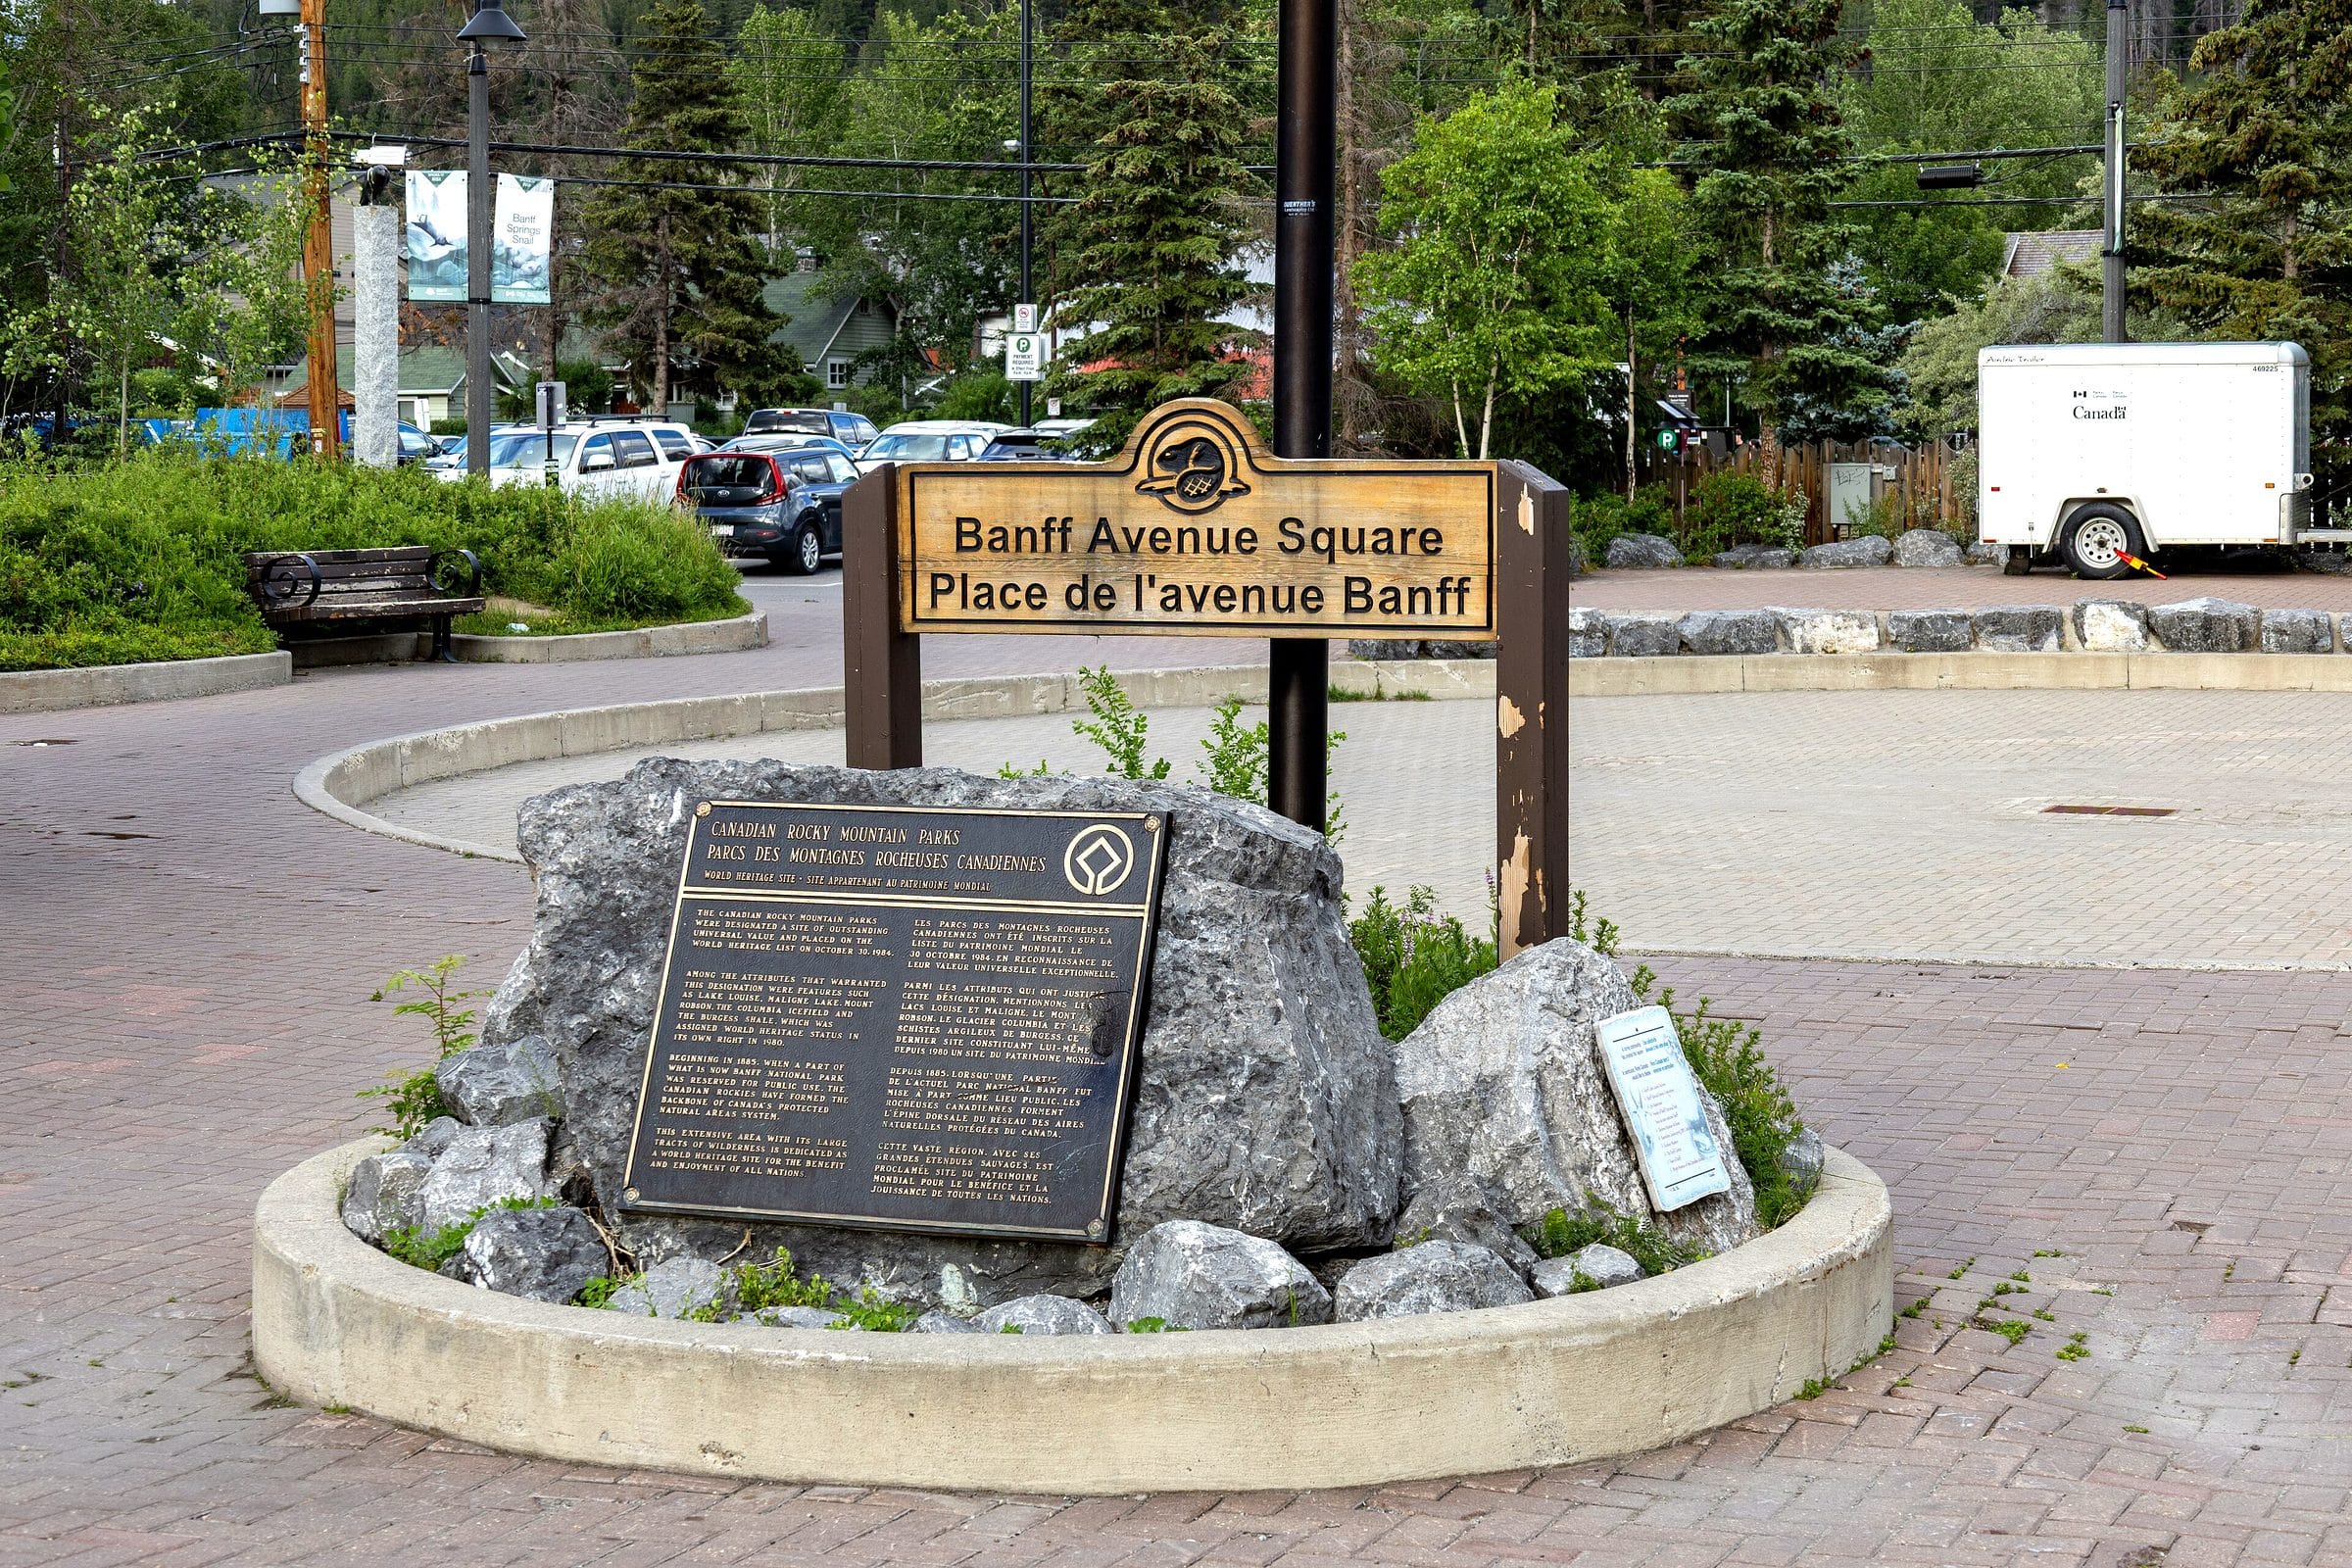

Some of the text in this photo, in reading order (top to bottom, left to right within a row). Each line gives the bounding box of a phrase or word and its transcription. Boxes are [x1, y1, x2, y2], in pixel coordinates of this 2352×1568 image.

[513, 213, 536, 223] Banff
[507, 223, 541, 236] Springs
[512, 235, 534, 245] Snail
[2073, 405, 2127, 419] Canada
[955, 516, 1444, 564] Banff Avenue Square
[930, 573, 1473, 616] Place de l'avenue Banff
[710, 820, 960, 845] CANADIAN ROCKY MOUNTAIN PARKS
[707, 843, 1046, 872] PARCS DES MONTAGNES ROCHEUSES CANADIENNES
[704, 869, 990, 893] WORLD HERITAGE SITE SITE APPARTENANT AU PATRIMOINE MONDIAL
[697, 908, 877, 925] THE CANADIAN ROCKY MOUNTAIN PARKS
[694, 918, 721, 927] WERE
[724, 920, 778, 930] DESIGNATED
[789, 923, 809, 932] SITE
[828, 925, 888, 935] OUTSTANDING
[913, 918, 1109, 934] LES PARCS DES MONTAGNES ROCHEUSES
[693, 929, 743, 939] UNIVERSAL
[747, 931, 775, 941] VALUE
[779, 933, 798, 942] AND
[801, 934, 836, 944] PLACED
[910, 939, 1083, 955] LISTE DU PATRIMOINE MONDIAL LE
[906, 960, 931, 969] LEUR
[935, 961, 969, 971] VALEUR
[974, 963, 1037, 974] UNIVERSELLE
[685, 969, 887, 988] AMONG THE ATTRIBUTES THAT WARRANTED
[691, 1034, 711, 1043] OWN
[716, 1035, 744, 1044] RIGHT
[895, 1035, 937, 1045] DERNIER
[942, 1037, 964, 1047] SITE
[969, 1039, 1033, 1050] CONSTITUANT
[667, 1063, 694, 1072] WHAT
[710, 1065, 730, 1074] NOW
[732, 1067, 762, 1076] BANFF
[767, 1069, 812, 1080] NATIONAL
[818, 1073, 844, 1082] PARK
[662, 1085, 849, 1104] CANADIAN ROCKIES HAVE FORMED THE
[659, 1105, 701, 1115] NATURAL
[705, 1108, 737, 1118] AREAS
[661, 1096, 709, 1106] BACKBONE
[778, 1102, 829, 1113] PROTECTED
[885, 1099, 1064, 1116] ROCHEUSES CANADIENNES FORMENT
[925, 1111, 968, 1122] DORSALE
[972, 1114, 986, 1123] DU
[1031, 1117, 1050, 1127] DES
[1054, 1119, 1084, 1129] AIRES
[656, 1127, 848, 1148] THIS EXTENSIVE AREA WITH ITS LARGE
[654, 1138, 848, 1158] TRACTS OF WILDERNESS IS DEDICATED AS
[672, 1161, 726, 1172] ENJOYMENT
[728, 1164, 741, 1173] OF
[743, 1165, 762, 1175] ALL
[934, 1167, 956, 1177] SITE
[960, 1169, 974, 1178] DU
[980, 1170, 1038, 1182] PATRIMOINE
[872, 1174, 915, 1185] MONDIAL
[919, 1177, 944, 1187] POUR
[950, 1179, 962, 1188] LE
[1018, 1183, 1031, 1192] ET
[1035, 1184, 1049, 1193] LA
[870, 1185, 927, 1197] JOUISSANCE
[931, 1189, 943, 1198] DE
[946, 1190, 982, 1200] TOUTES
[986, 1192, 1004, 1201] LES
